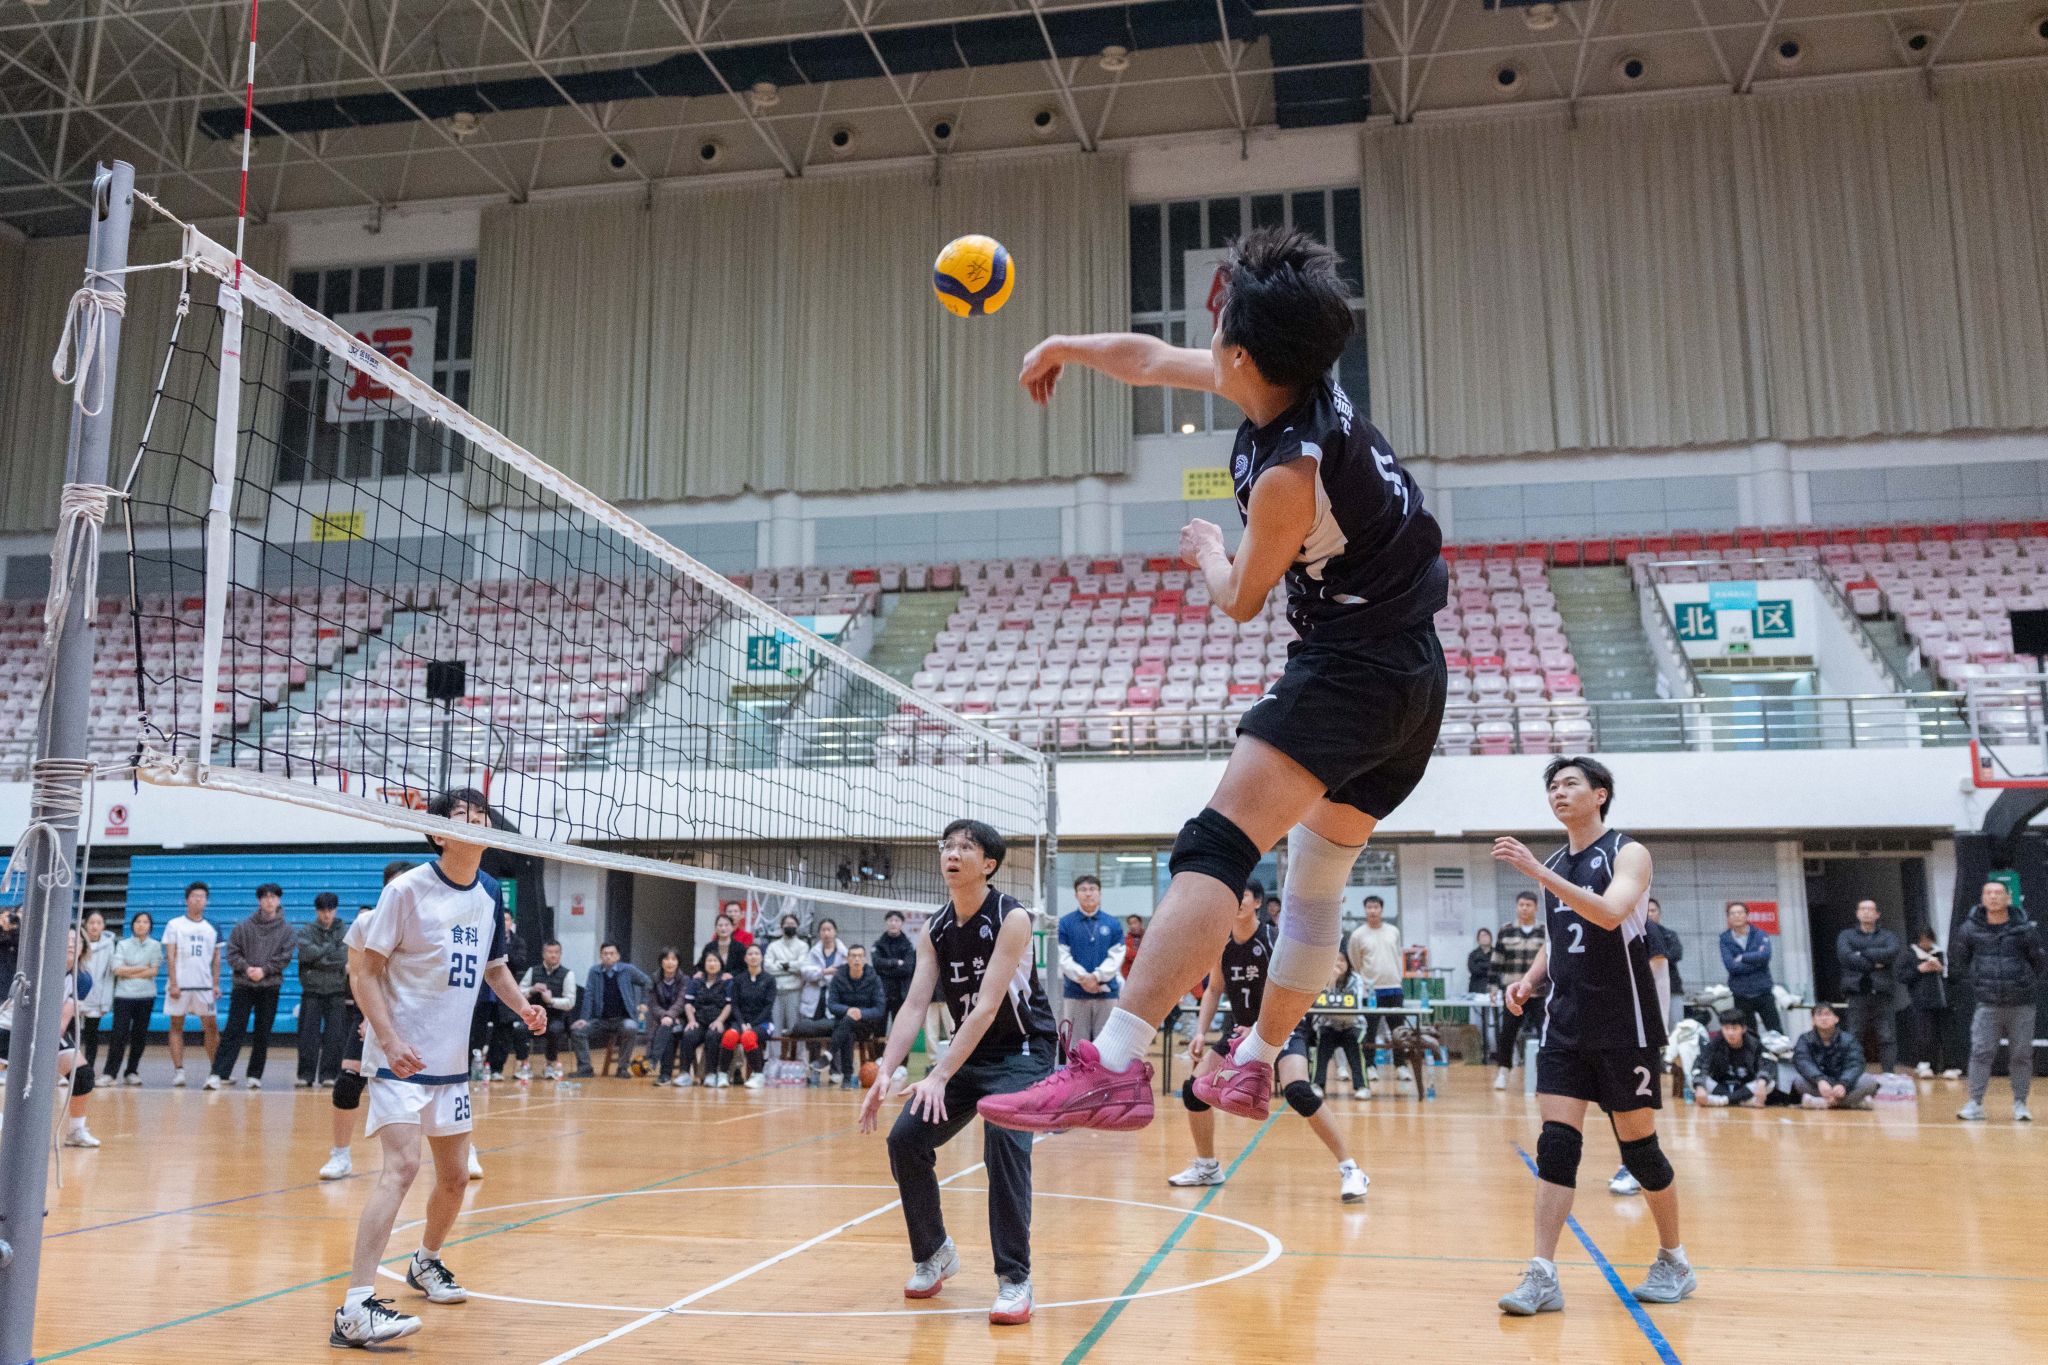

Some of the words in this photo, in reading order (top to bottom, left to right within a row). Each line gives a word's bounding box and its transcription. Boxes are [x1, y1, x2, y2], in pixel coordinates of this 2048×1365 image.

[451, 924, 478, 947] 食科
[1567, 922, 1586, 954] 2
[191, 945, 203, 957] 16
[448, 952, 478, 989] 25
[1231, 965, 1260, 982] 工学
[1241, 988, 1250, 1009] 7
[1633, 1065, 1653, 1097] 2
[454, 1094, 471, 1122] 25
